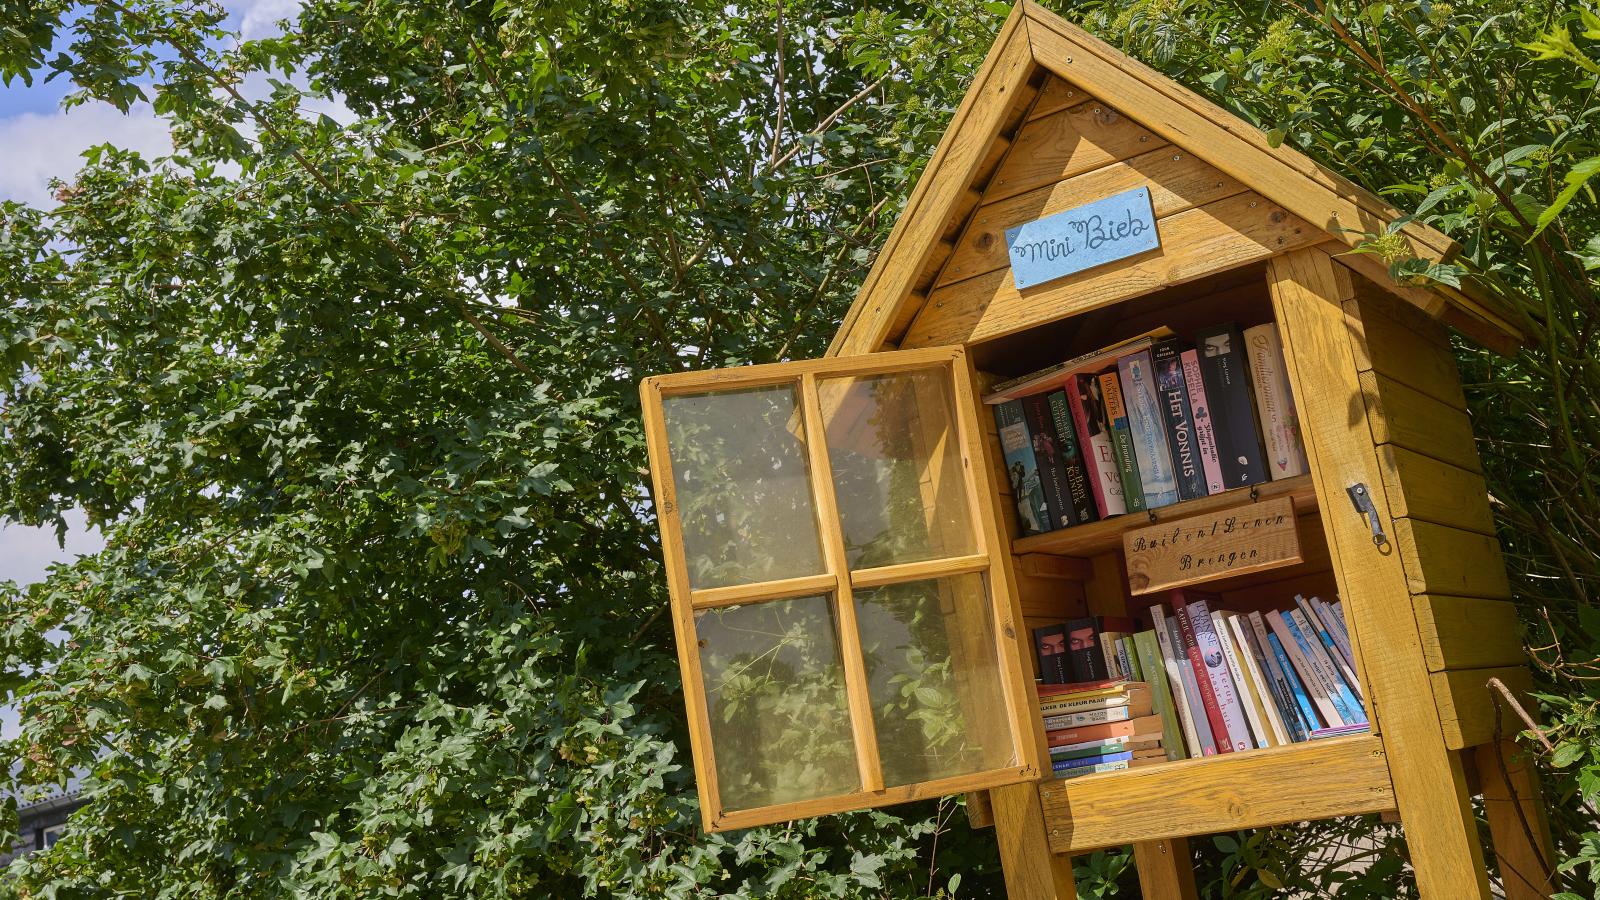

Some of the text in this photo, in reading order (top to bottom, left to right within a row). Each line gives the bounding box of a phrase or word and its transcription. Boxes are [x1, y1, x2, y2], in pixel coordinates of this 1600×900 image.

[1012, 209, 1149, 263] Mini Bieb
[1104, 376, 1118, 416] WALTERS
[1184, 362, 1198, 405] KINSELLA
[1190, 360, 1203, 393] SOPHIE
[1051, 400, 1066, 442] CUTHBERT
[1058, 399, 1072, 439] MARGARET
[1120, 434, 1132, 473] De branding
[1175, 420, 1195, 477] VONNIS
[1203, 447, 1208, 455] in
[1204, 423, 1217, 462] Shopaholic
[1191, 618, 1206, 641] RICE
[1196, 604, 1218, 646] LUANNE
[1210, 673, 1232, 729] naar huis
[1219, 668, 1234, 704] Terug
